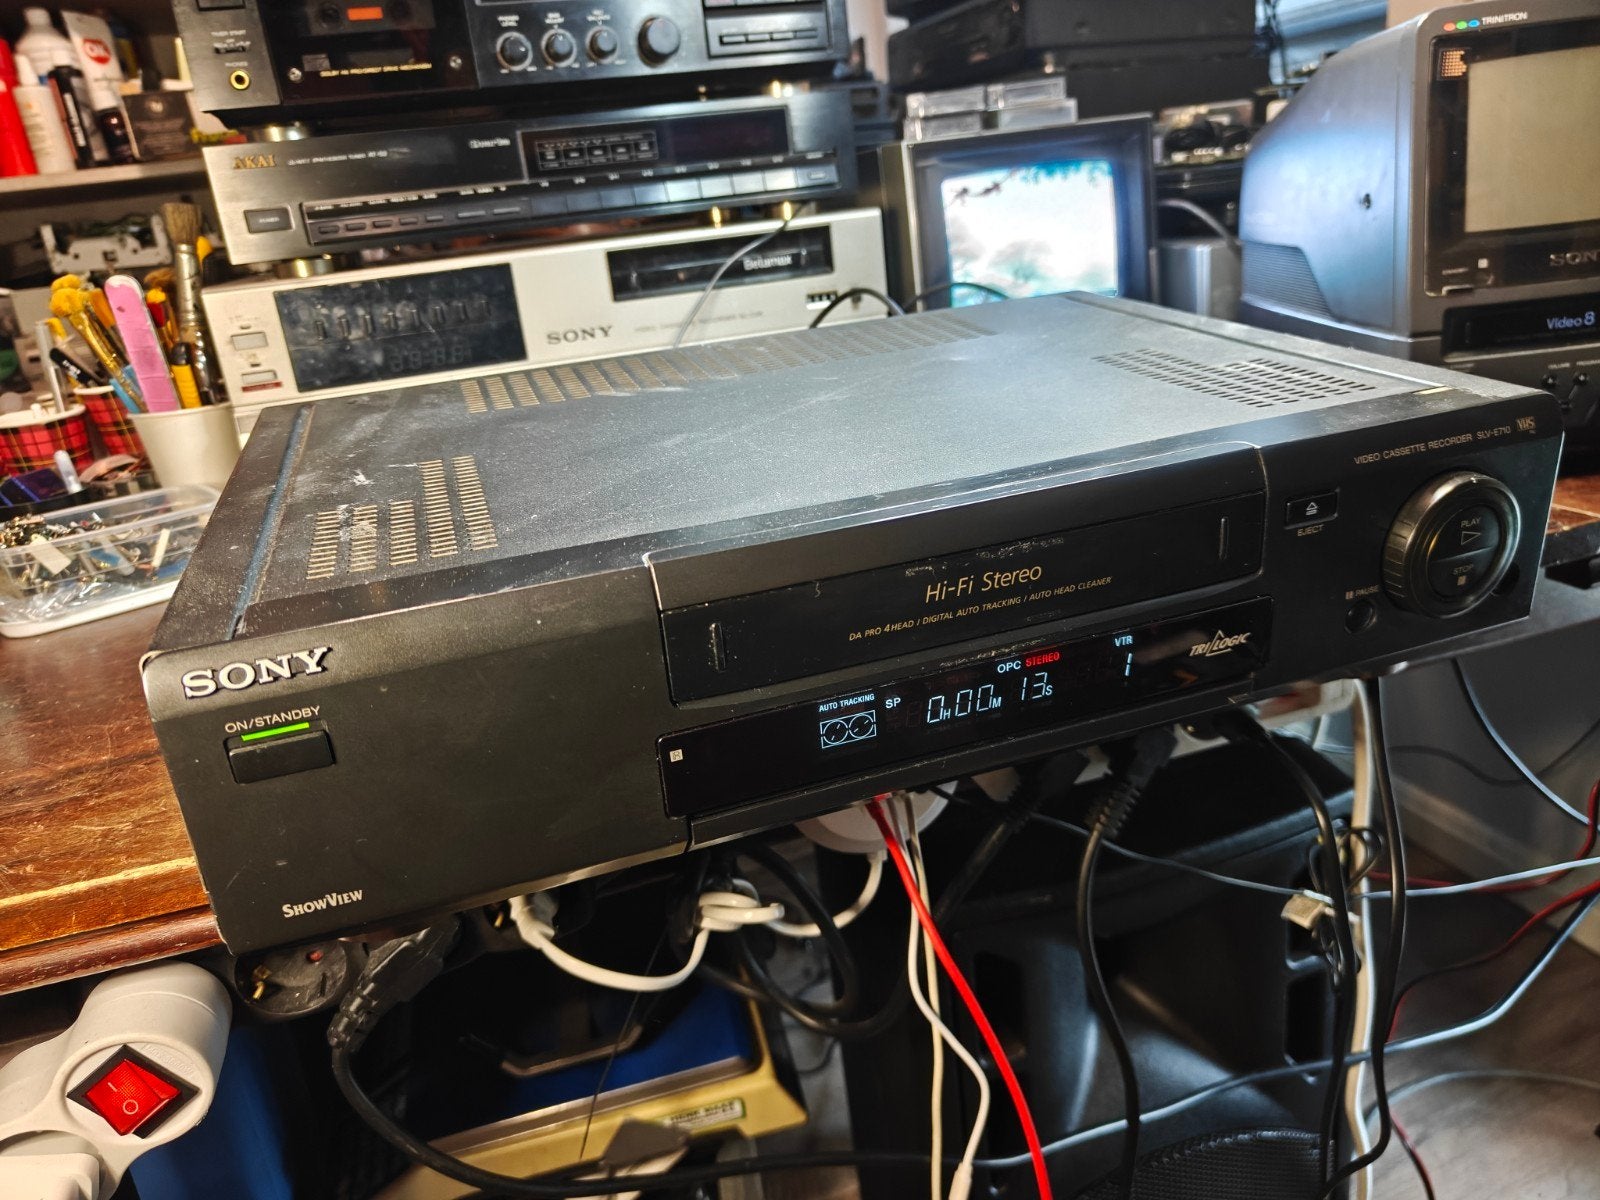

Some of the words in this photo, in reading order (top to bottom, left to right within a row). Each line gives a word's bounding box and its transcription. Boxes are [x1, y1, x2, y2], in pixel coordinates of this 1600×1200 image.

[1482, 12, 1528, 25] TRINITRON
[233, 154, 277, 170] AKAI
[1550, 251, 1600, 266] SON
[1547, 318, 1583, 329] Video
[1584, 311, 1596, 326] 8
[547, 325, 614, 345] SONY
[1354, 453, 1381, 465] VIDEO
[1383, 443, 1426, 460] CASSETTE
[1428, 433, 1473, 450] RECORDER
[1476, 425, 1511, 440] SLV-E710
[1297, 524, 1325, 537] EJECT
[1460, 517, 1482, 528] PLAY
[925, 575, 974, 603] Hi-Fi
[981, 565, 1043, 592] Stereo
[1355, 584, 1381, 597] PAUSE
[849, 632, 862, 641] DA
[864, 627, 882, 638] PRO
[922, 610, 954, 625] DIGITAL
[956, 605, 980, 618] AUTO
[982, 596, 1022, 612] TRACKING
[1028, 589, 1053, 602] AUTO
[1053, 584, 1077, 596] HEAD
[1077, 576, 1113, 591] CLEANER
[1114, 635, 1133, 646] VTR
[997, 660, 1022, 673] OPC
[1025, 651, 1060, 668] STEREO
[181, 646, 330, 700] SONY
[819, 702, 838, 712] AUTO
[840, 693, 875, 707] TRACKING
[885, 697, 901, 709] SP
[224, 706, 320, 733] ON/STANDBY
